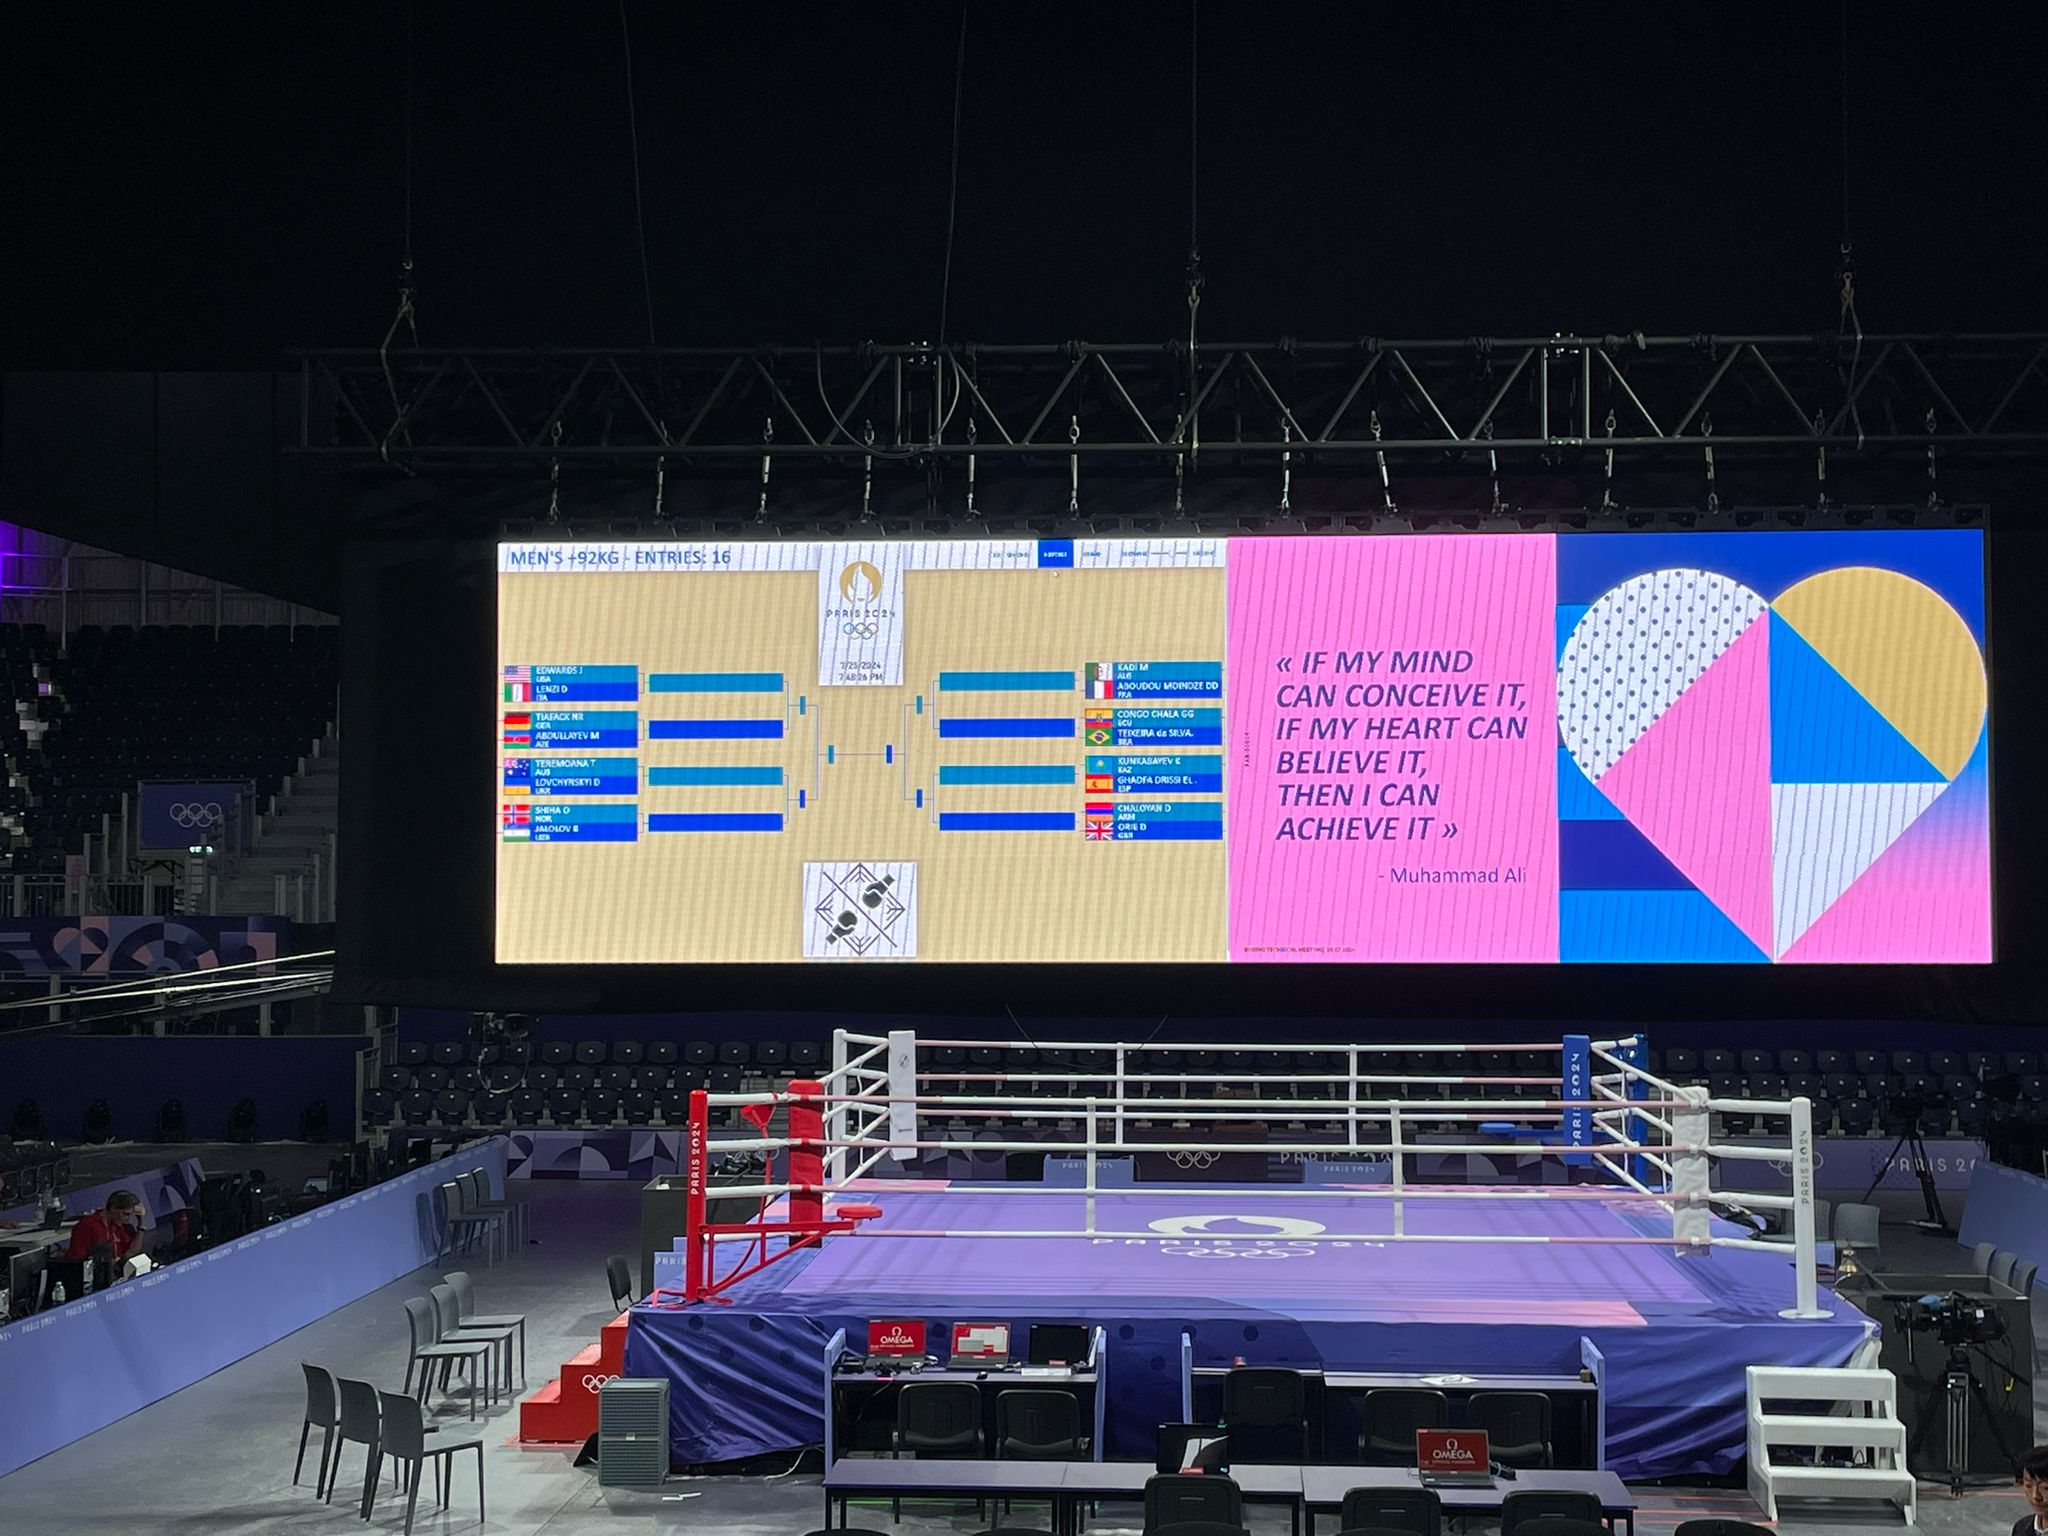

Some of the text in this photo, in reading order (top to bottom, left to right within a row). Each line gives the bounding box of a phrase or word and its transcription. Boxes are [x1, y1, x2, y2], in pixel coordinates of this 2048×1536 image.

[511, 551, 563, 565] MEN'S
[568, 551, 619, 565] +92KG
[635, 551, 706, 565] ENTRIES:
[713, 551, 731, 564] 16
[826, 609, 895, 618] PARIS 2024
[1302, 651, 1327, 674] IF
[1335, 651, 1384, 674] MY
[1390, 650, 1473, 674] MIND
[870, 673, 882, 681] PM
[1117, 682, 1161, 690] ABOUDOU
[1276, 683, 1527, 711] CAN CONCEIVE IT,
[1117, 710, 1149, 718] CONGO
[1151, 710, 1179, 718] CHALA
[1276, 716, 1528, 740] IF MY HEART CAN
[1276, 750, 1428, 779] BELIEVE IT,
[594, 778, 600, 786] D
[1279, 783, 1440, 806] THEN I CAN
[1165, 804, 1171, 812] D
[1140, 823, 1147, 831] D
[1275, 817, 1400, 840] ACHIEVE
[1407, 817, 1435, 840] IT
[1390, 867, 1499, 884] Muhammad
[1504, 867, 1526, 883] Ali
[1571, 1053, 1580, 1096] 2024
[690, 1121, 700, 1195] PARIS 2024
[1800, 1131, 1810, 1205] PARIS 2024
[655, 1257, 687, 1265] PARIS
[1433, 1450, 1473, 1459] OMEGA
